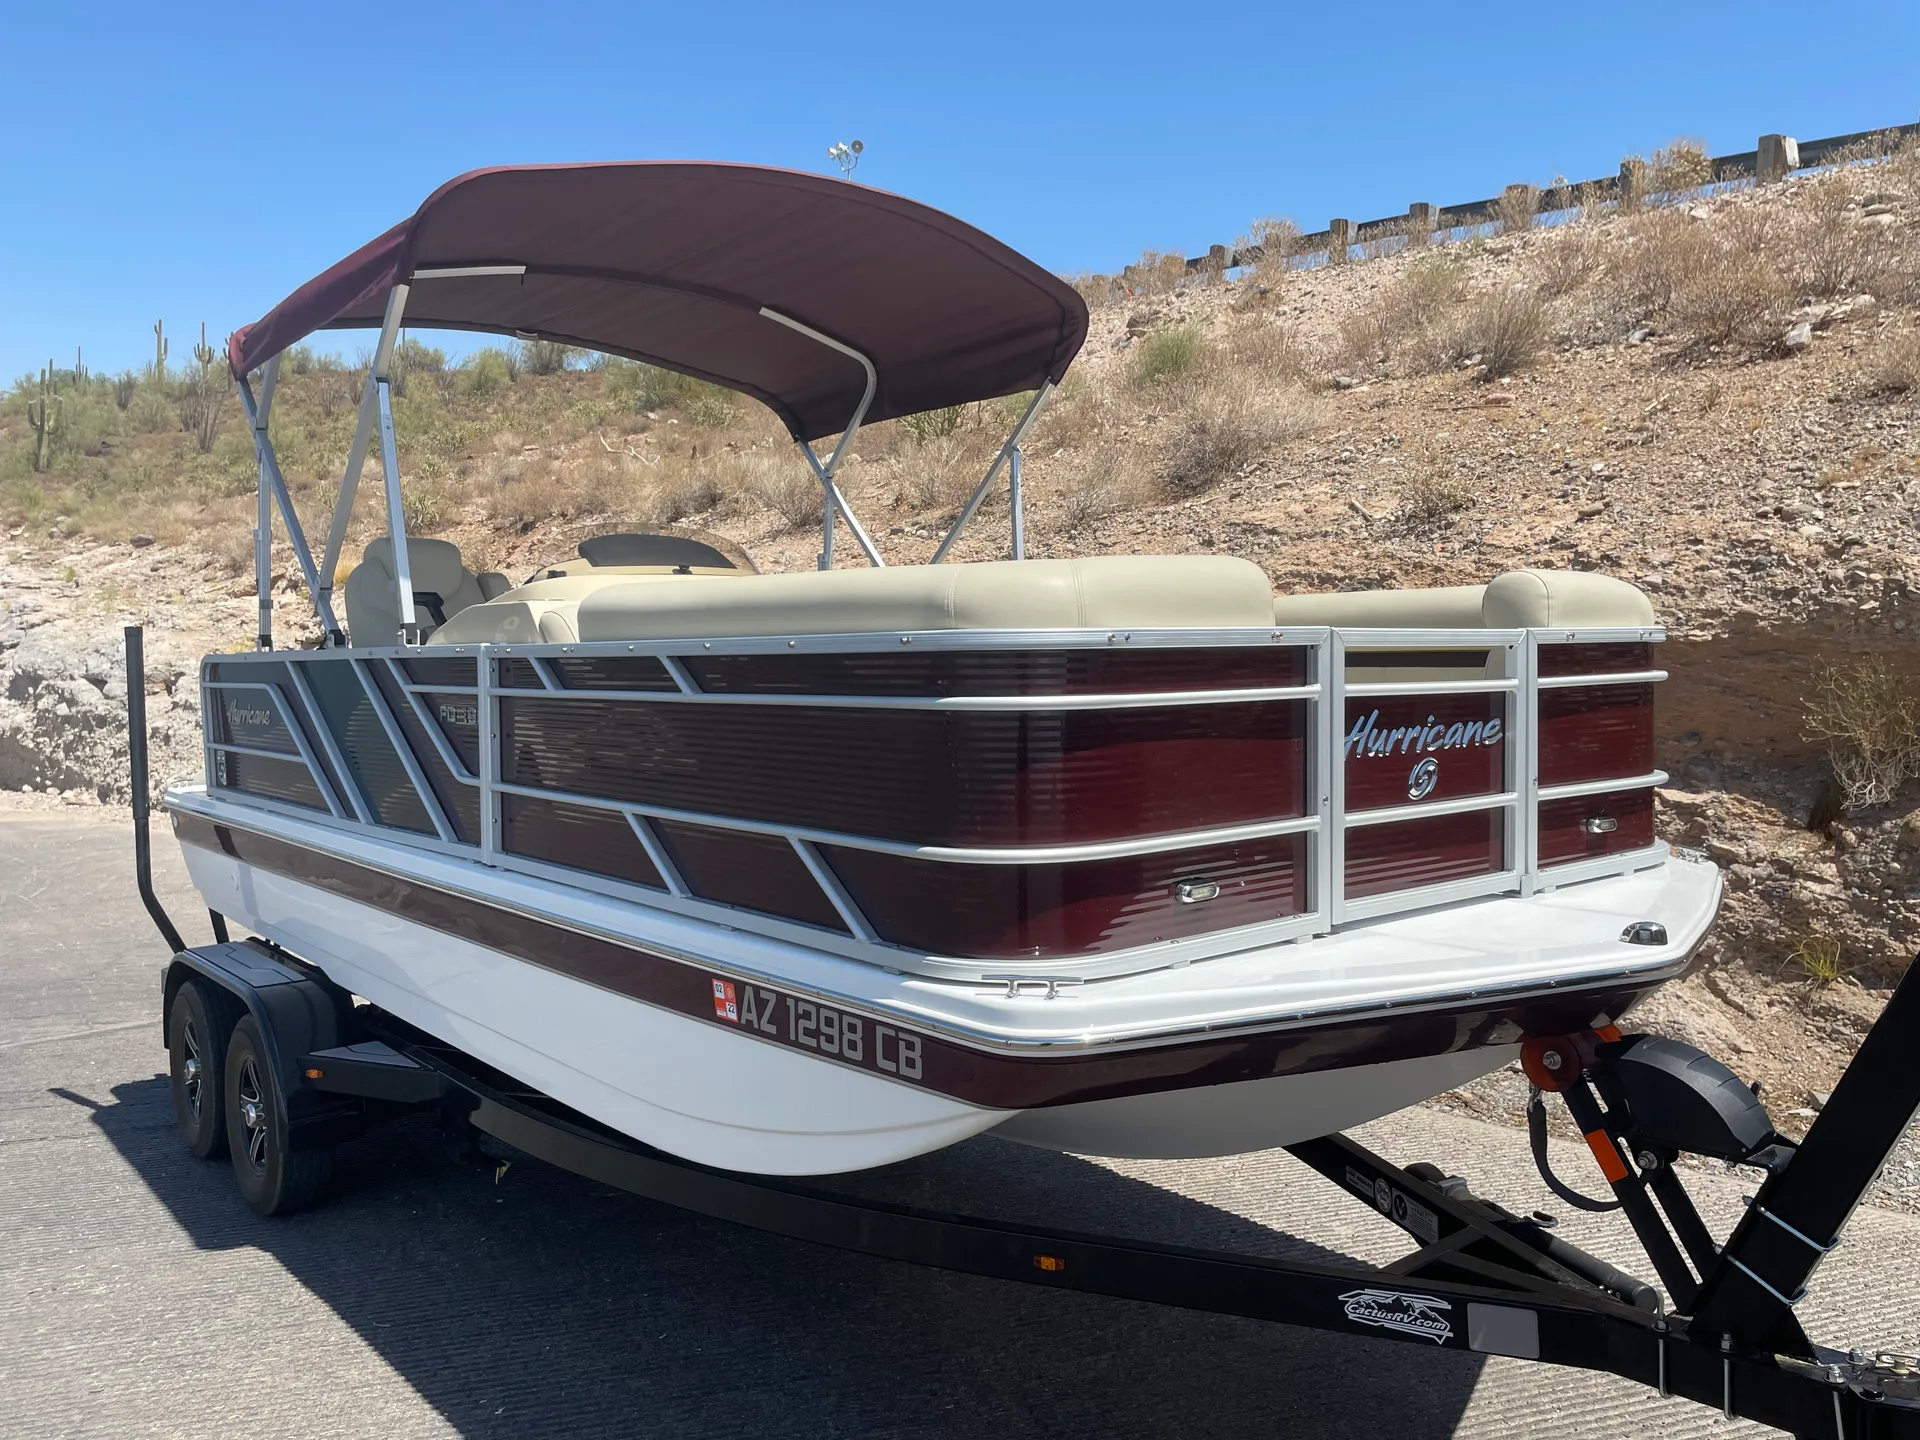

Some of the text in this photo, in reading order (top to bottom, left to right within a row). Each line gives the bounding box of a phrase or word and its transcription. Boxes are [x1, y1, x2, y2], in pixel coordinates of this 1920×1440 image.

[226, 698, 271, 726] Hurricane
[1344, 708, 1504, 762] Hurricane
[715, 983, 723, 994] 02
[727, 1003, 736, 1014] 22
[740, 985, 923, 1080] AZ 1298 CB
[1347, 1304, 1447, 1330] CactusRV.com
